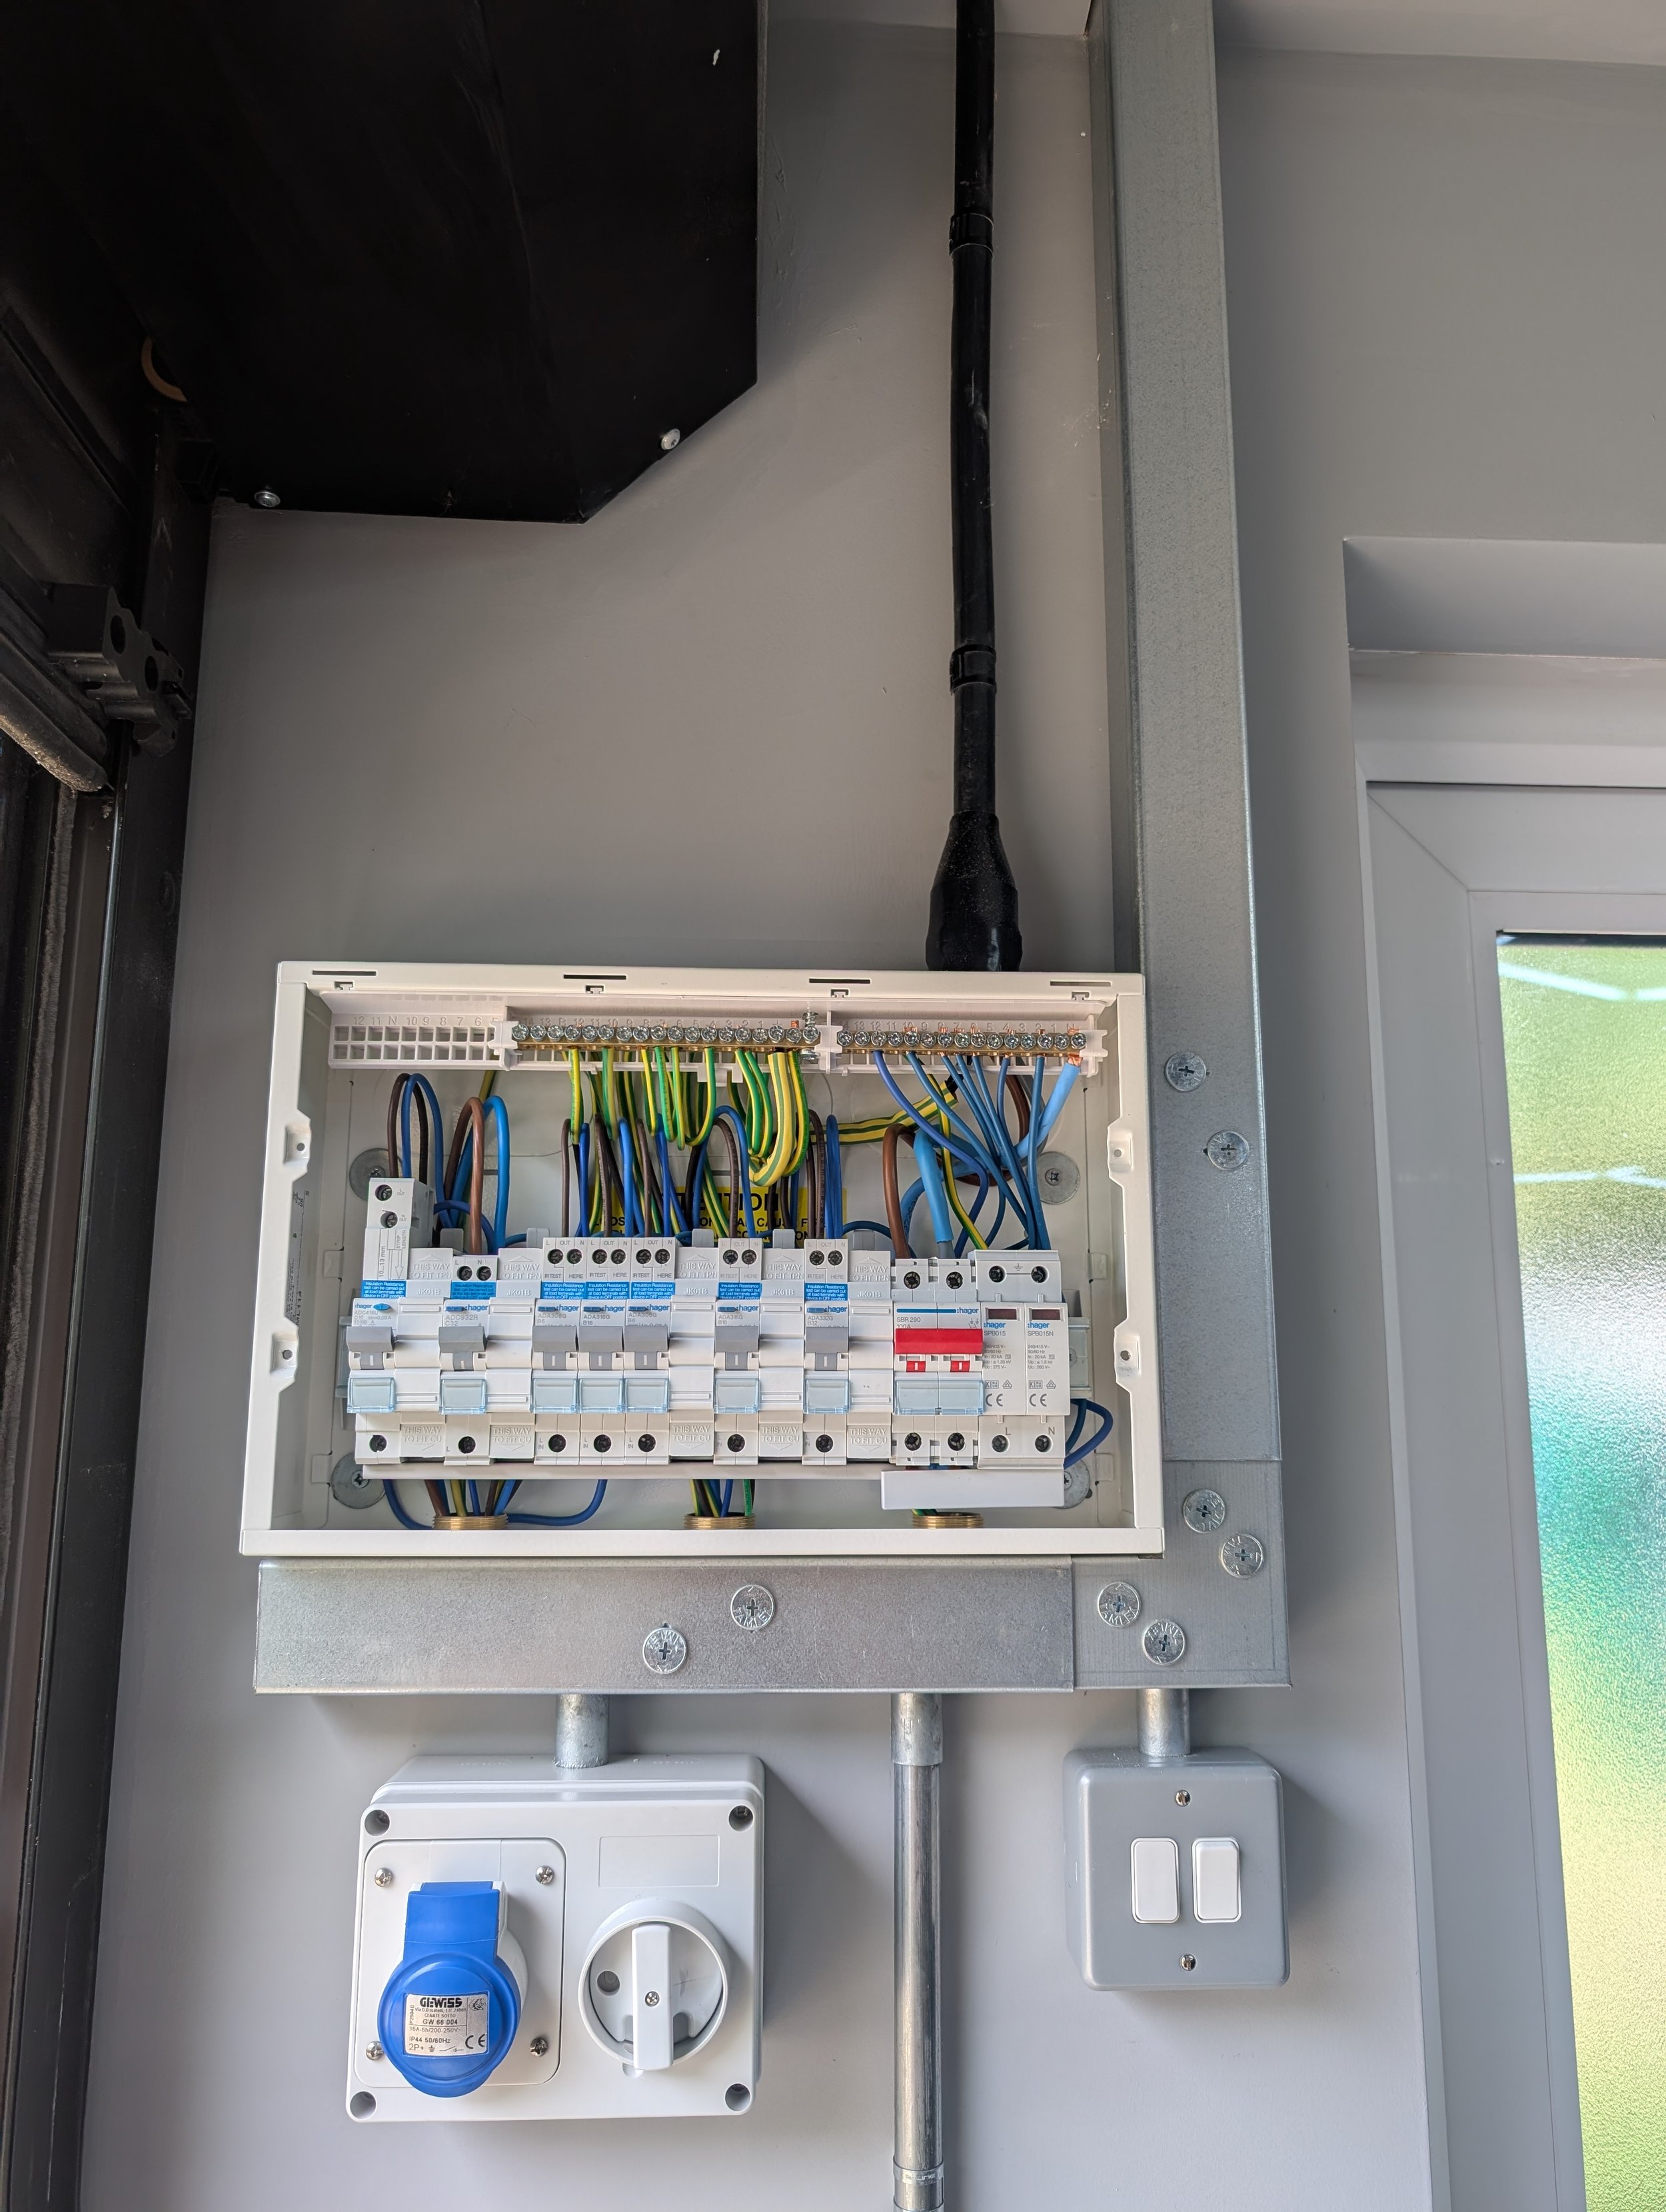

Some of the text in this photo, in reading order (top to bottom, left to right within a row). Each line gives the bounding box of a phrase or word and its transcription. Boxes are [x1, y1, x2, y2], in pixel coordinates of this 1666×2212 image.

[354, 1016, 365, 1025] 12
[407, 1017, 418, 1025] 10
[423, 1017, 430, 1025] 9
[440, 1017, 447, 1025] 8
[474, 1017, 482, 1026] 6
[921, 1022, 928, 1031] 9
[986, 1023, 993, 1031] 5
[1006, 1427, 1011, 1436] L
[1048, 1426, 1055, 1435] N
